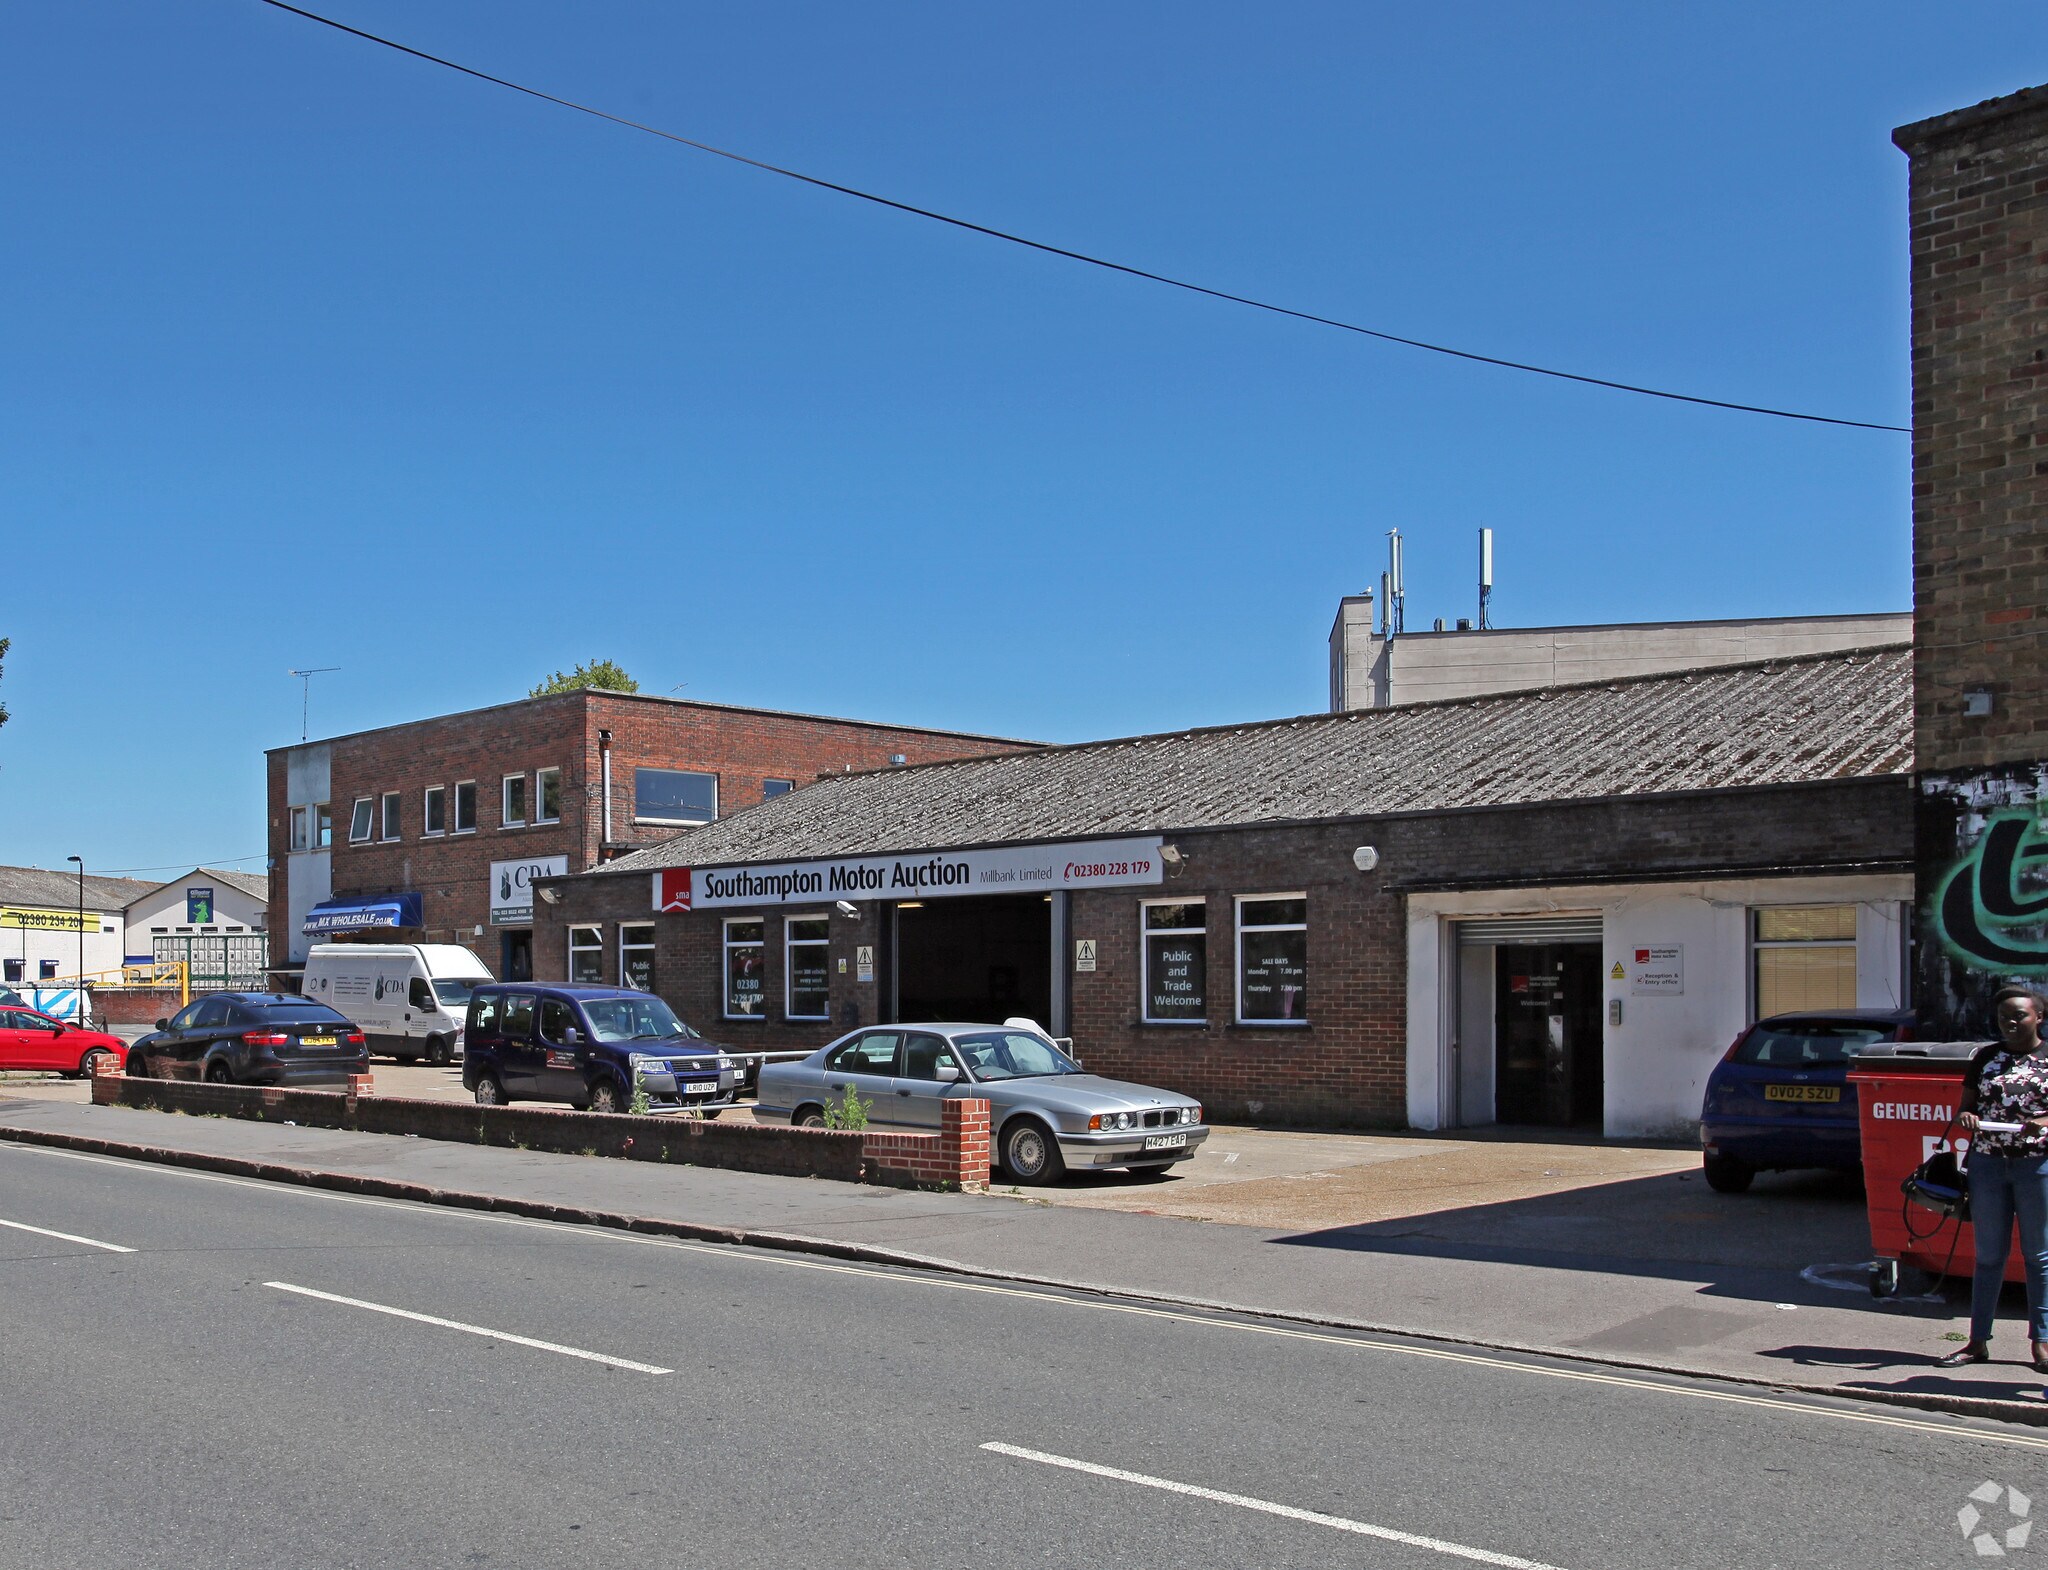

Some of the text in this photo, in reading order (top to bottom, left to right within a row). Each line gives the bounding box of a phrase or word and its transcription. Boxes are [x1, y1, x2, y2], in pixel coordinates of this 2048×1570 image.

[1074, 861, 1150, 877] 02380 228 179
[705, 857, 1052, 901] Southampton Motor Auction Millbank Limited
[675, 891, 690, 900] sma
[1162, 950, 1192, 961] Public
[1168, 965, 1187, 976] and
[385, 979, 405, 993] CDA
[736, 979, 759, 989] 02380
[1163, 980, 1192, 991] Trade
[1154, 995, 1202, 1006] Welcome
[1770, 1087, 1834, 1100] OV02 SZU
[1170, 1134, 1186, 1146] EAP
